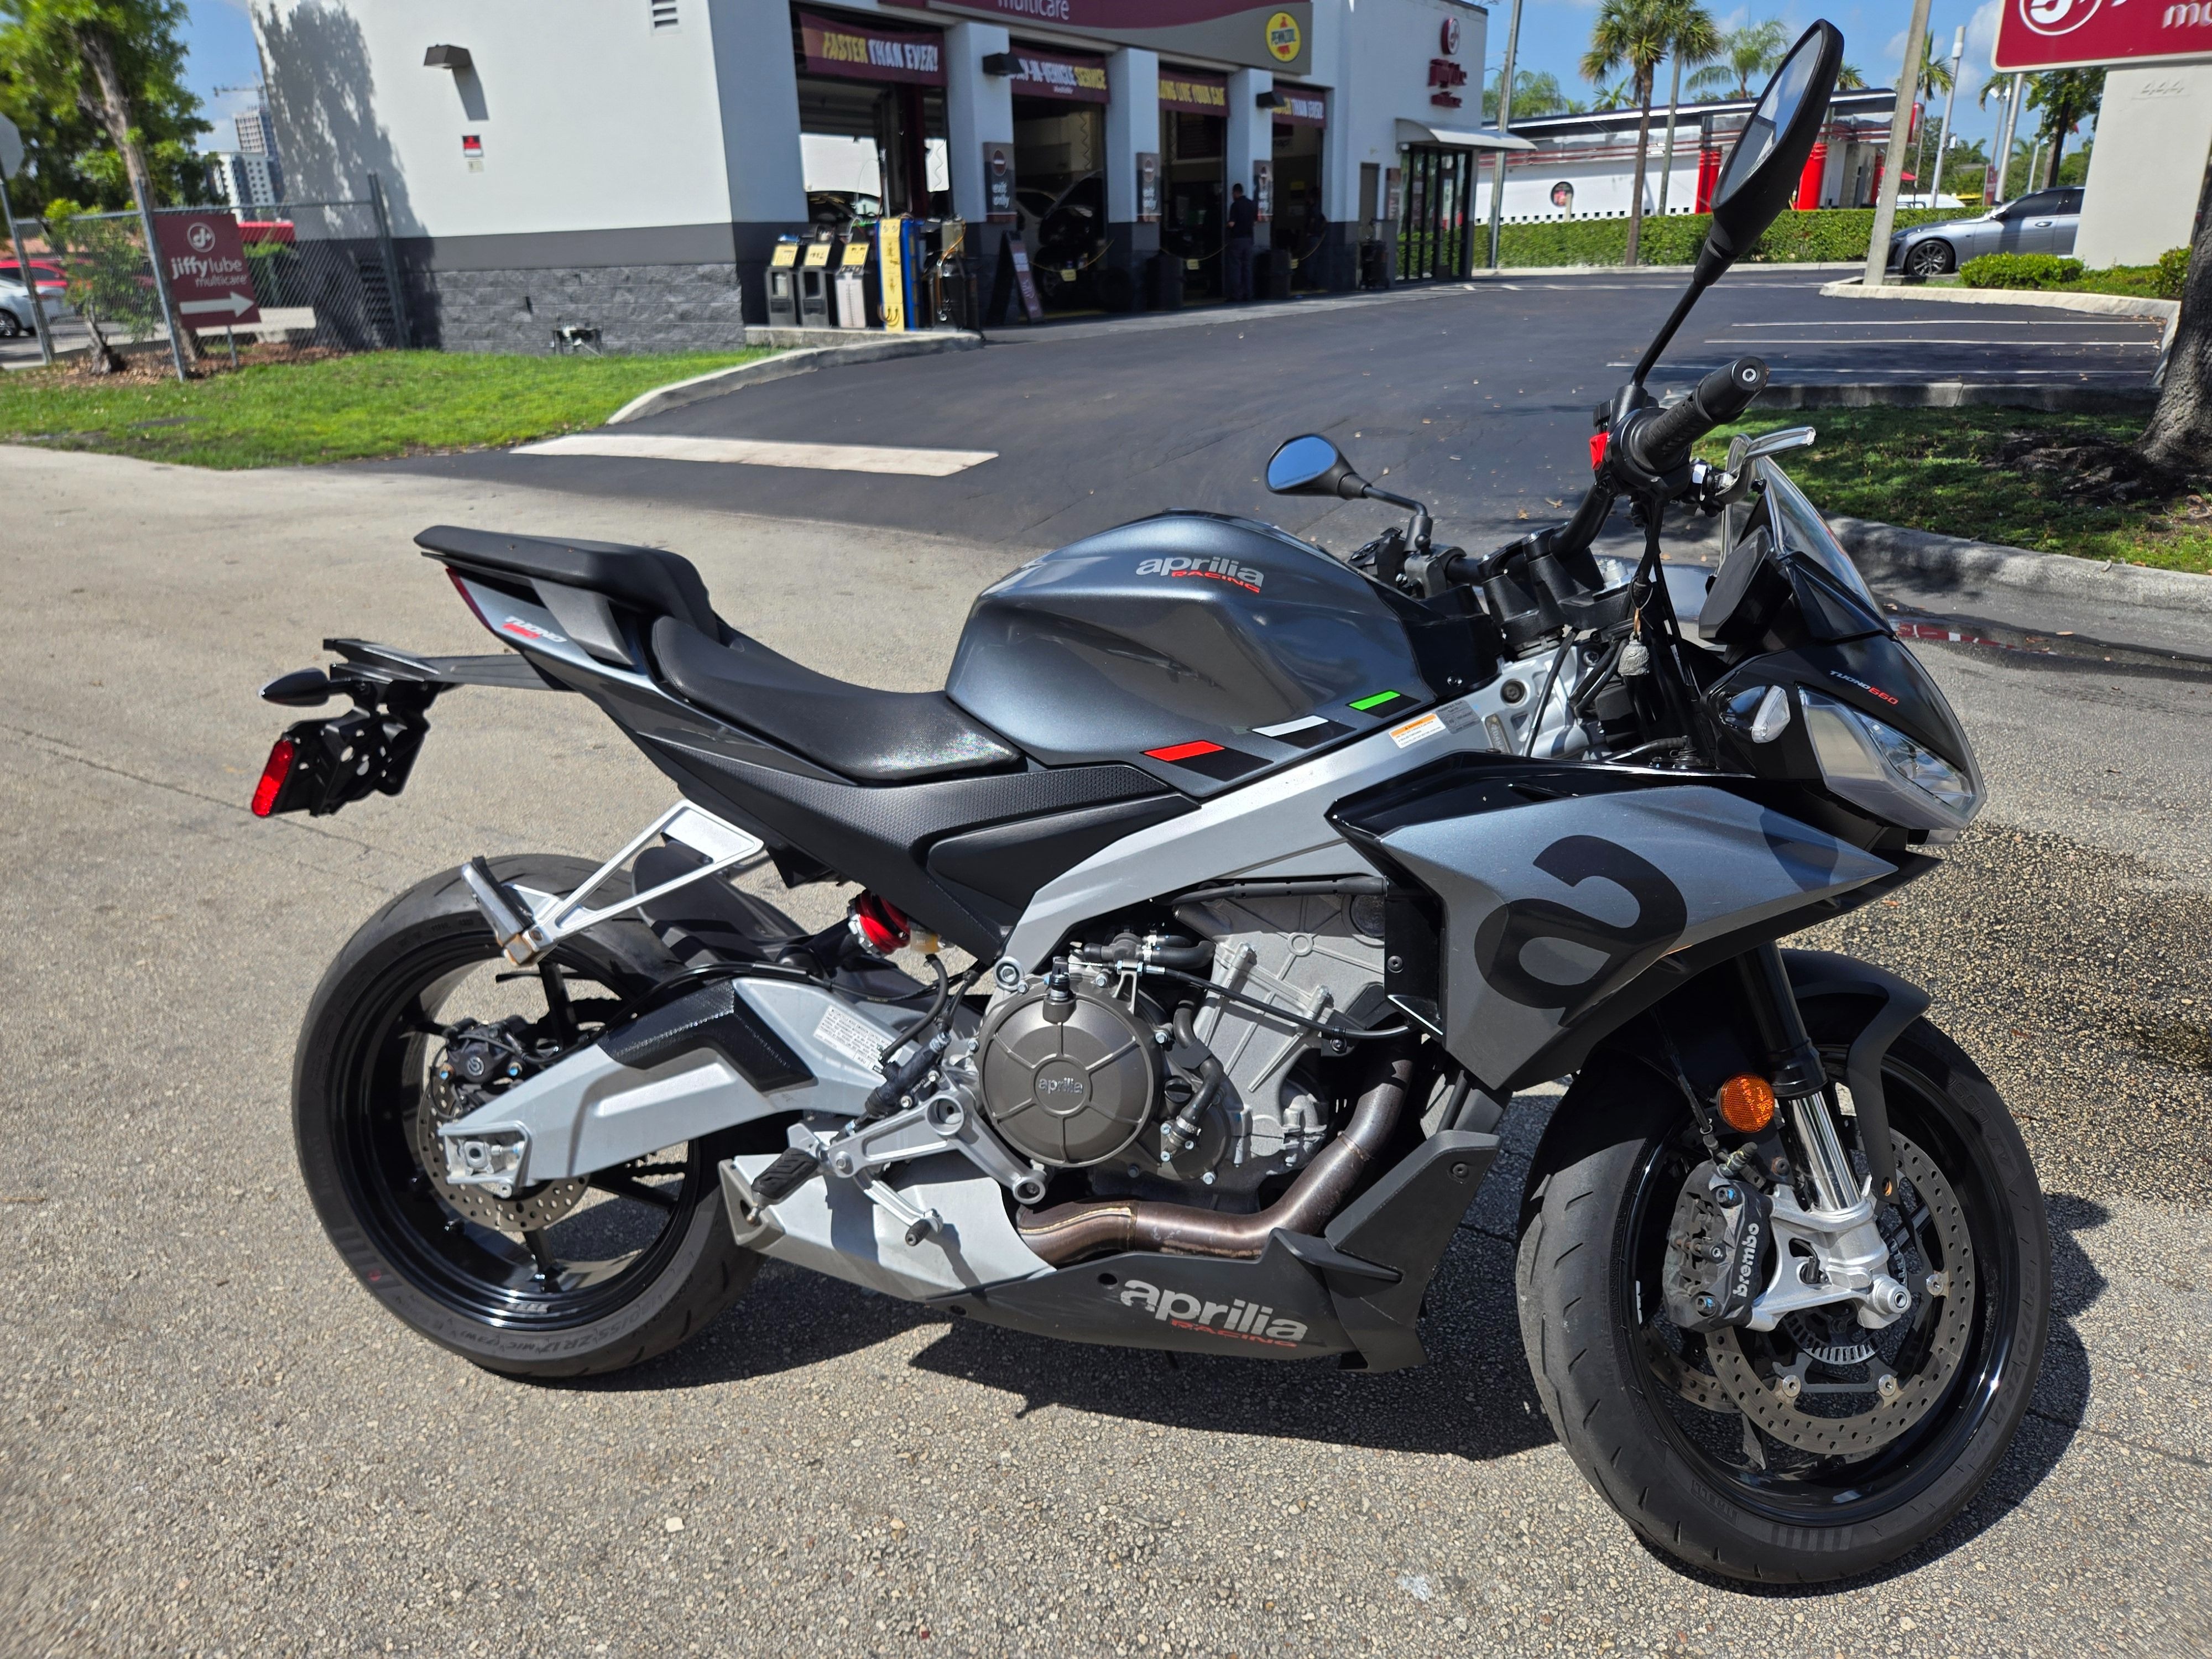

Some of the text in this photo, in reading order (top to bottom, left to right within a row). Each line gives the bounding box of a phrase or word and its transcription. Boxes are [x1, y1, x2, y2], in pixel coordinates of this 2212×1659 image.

[822, 32, 938, 72] FASTER THAN EVER!
[2140, 81, 2186, 95] 444
[170, 255, 243, 280] jiffy lube
[195, 274, 247, 288] multicare
[1136, 556, 1264, 588] aprilia
[1171, 570, 1261, 593] RACING
[505, 615, 567, 643] TUONO
[1039, 1077, 1083, 1094] aprilia
[1733, 1223, 1760, 1297] brembo
[1120, 1280, 1308, 1342] aprilia
[1171, 1318, 1298, 1348] RACING
